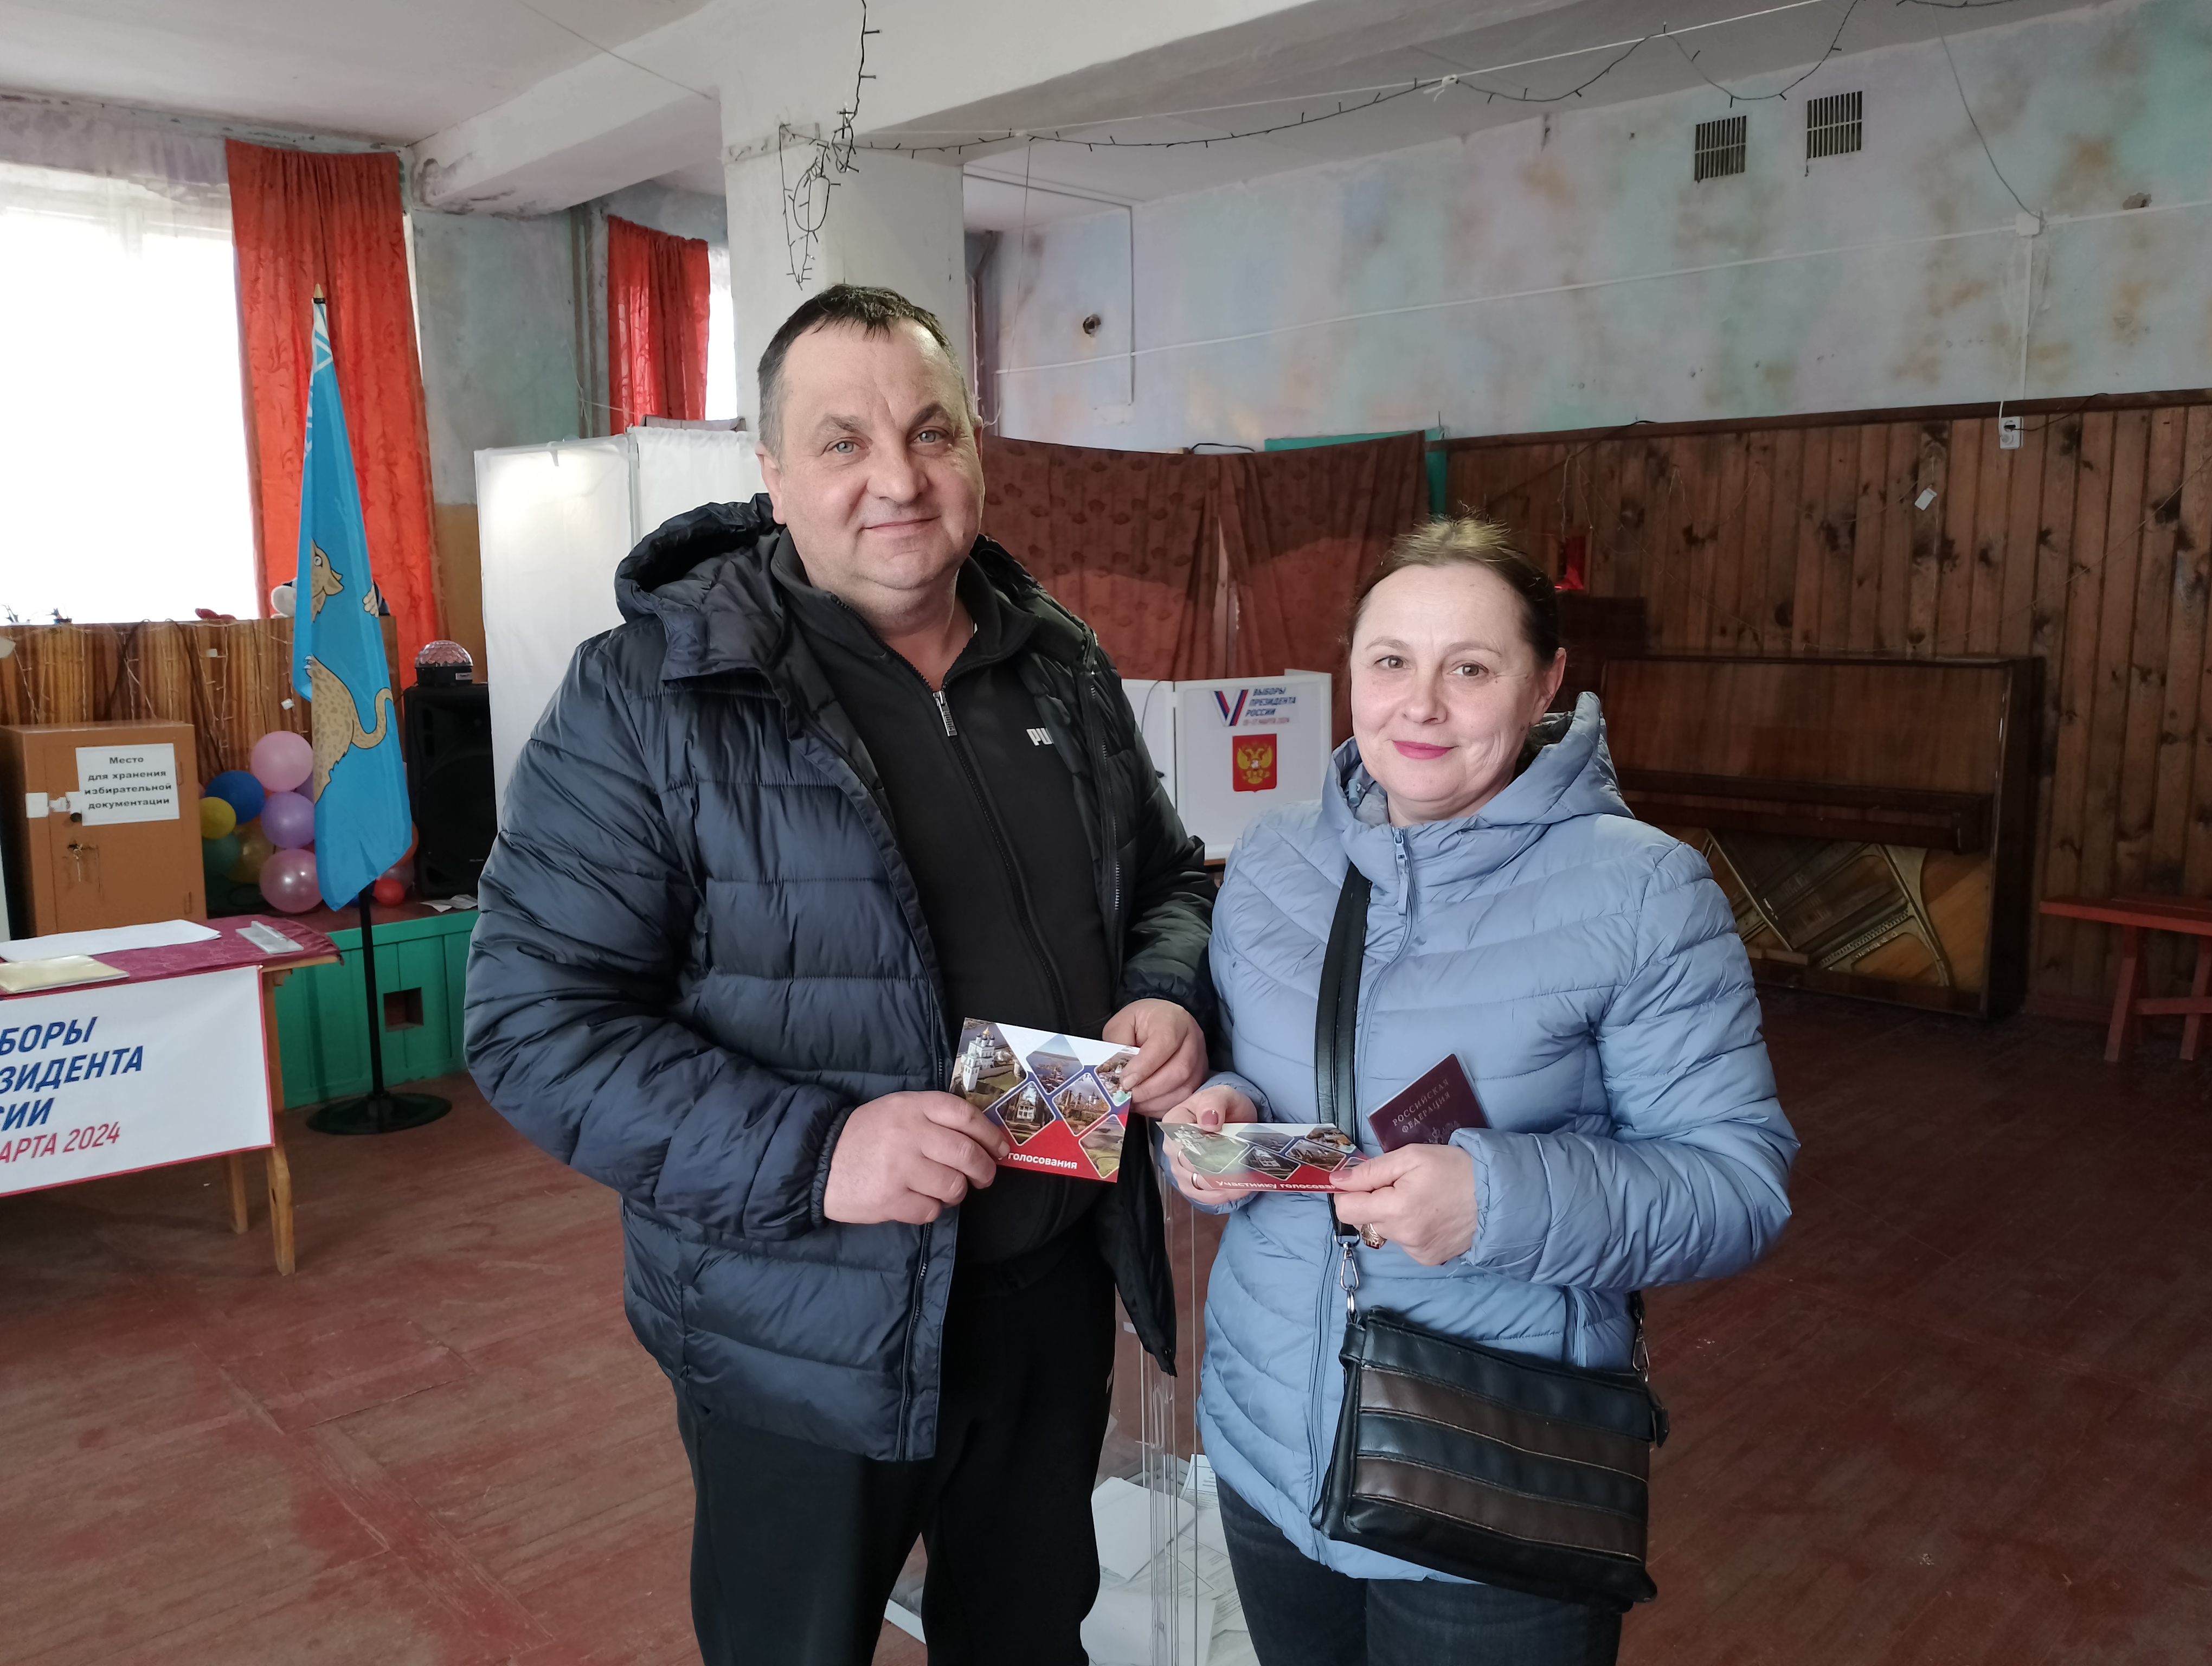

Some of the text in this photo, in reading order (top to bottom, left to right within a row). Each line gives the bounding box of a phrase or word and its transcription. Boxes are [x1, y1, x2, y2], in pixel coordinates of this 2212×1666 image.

[1245, 708, 1276, 716] РОССИИ
[1026, 727, 1054, 746] PU
[112, 771, 166, 780] хранения
[85, 783, 172, 795] избирательной
[88, 798, 170, 810] документации
[1392, 1079, 1449, 1126] РОССИЙСКАЯ
[1401, 1091, 1450, 1133] ФЕДЕРАЦИЯ
[62, 1122, 120, 1153] 2024
[1008, 1152, 1078, 1169] голосования
